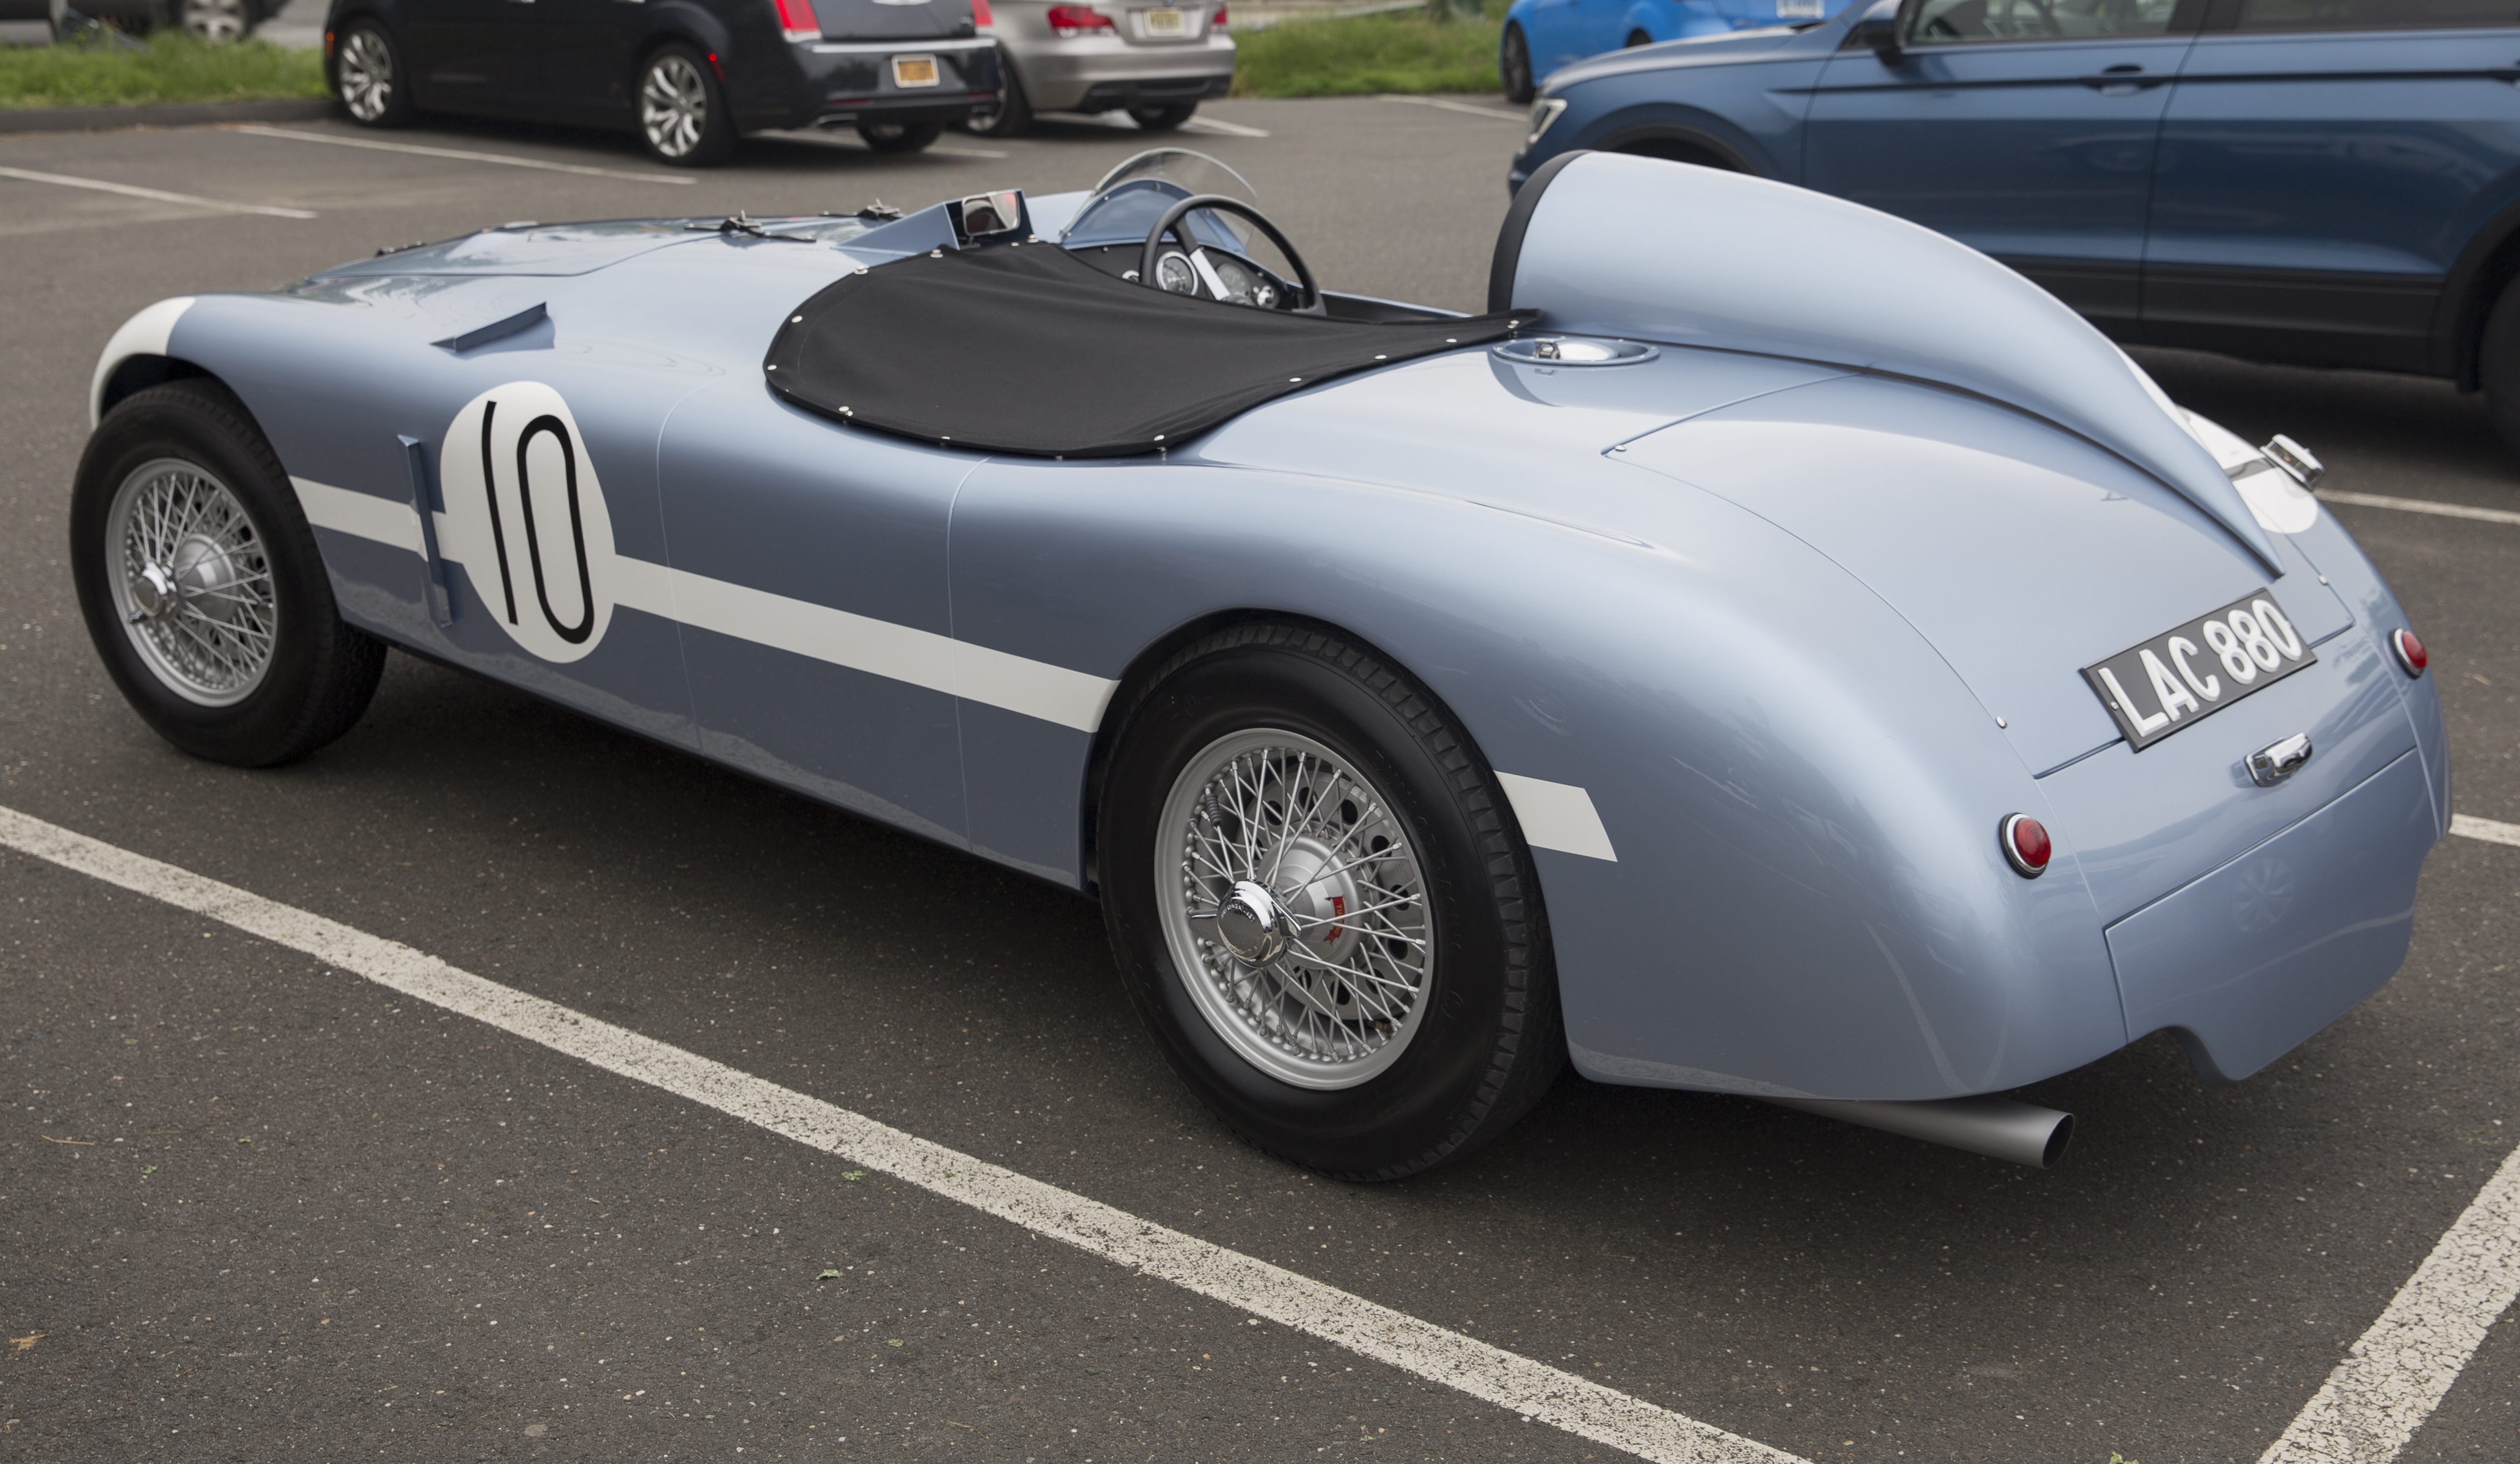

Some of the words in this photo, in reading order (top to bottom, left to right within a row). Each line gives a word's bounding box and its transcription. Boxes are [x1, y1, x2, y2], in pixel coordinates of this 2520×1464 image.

[482, 400, 594, 644] 10
[2098, 636, 2220, 736] LAC
[2203, 599, 2302, 684] 880
